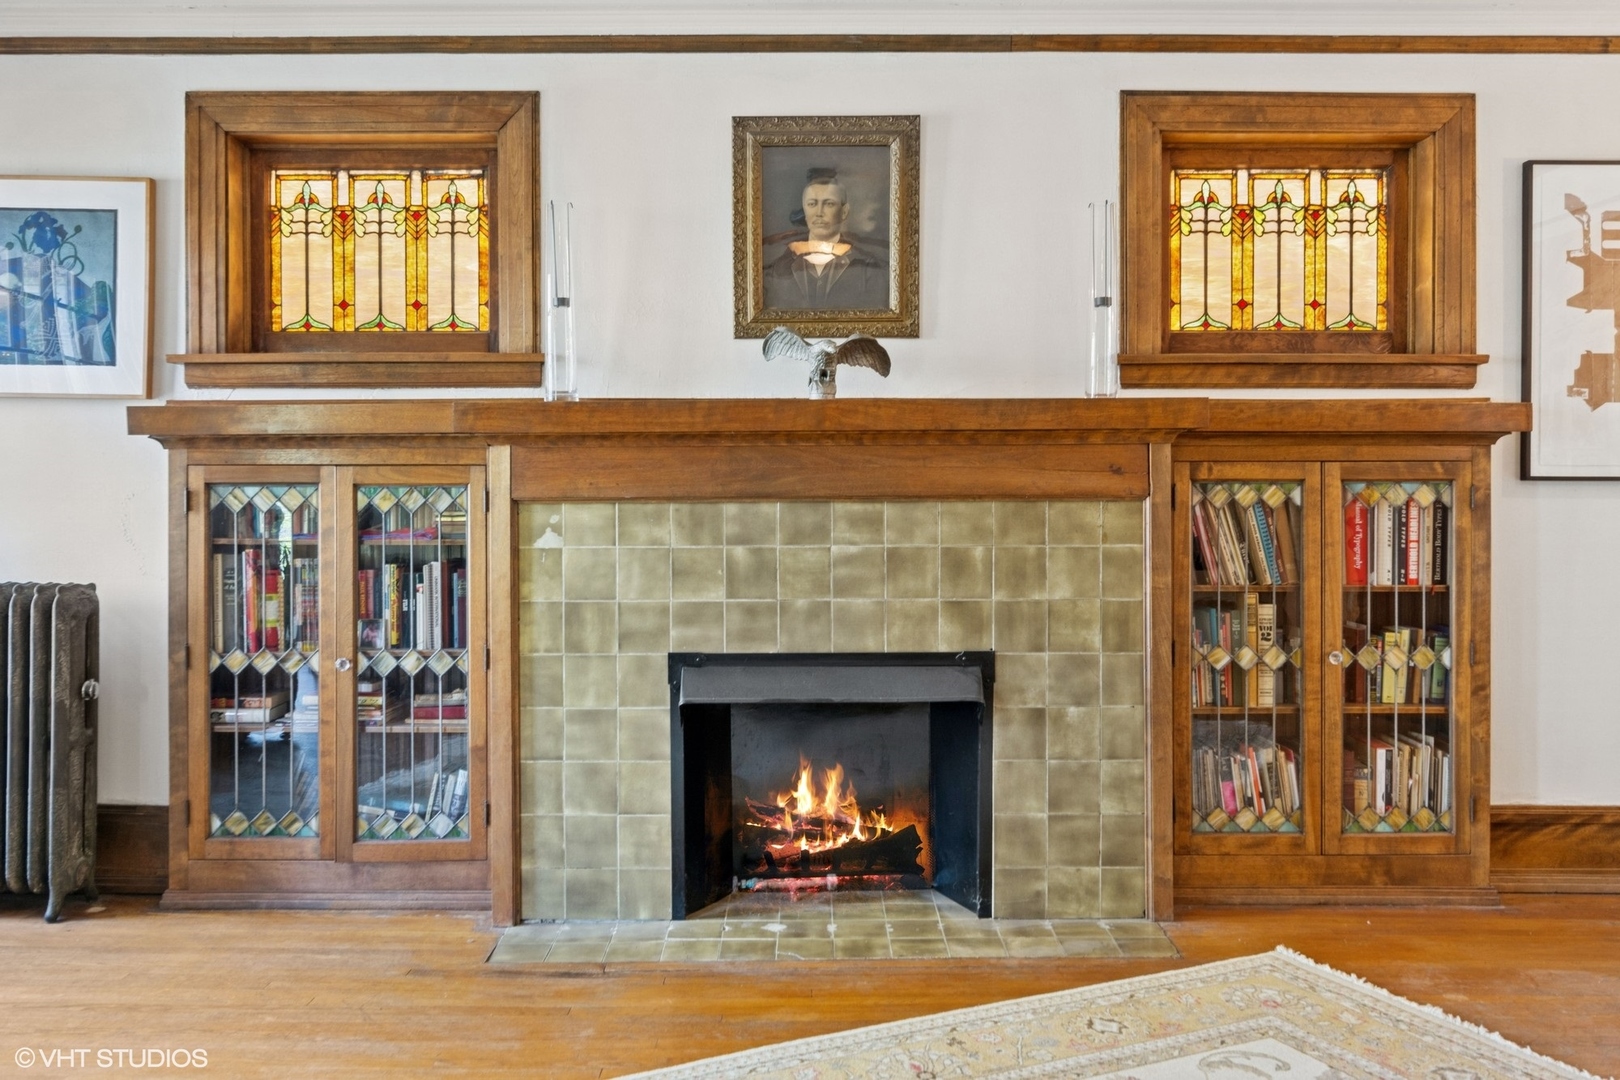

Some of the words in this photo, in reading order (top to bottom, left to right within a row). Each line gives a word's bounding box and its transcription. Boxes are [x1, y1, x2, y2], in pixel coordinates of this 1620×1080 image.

[1409, 501, 1419, 541] HEADLINES
[1434, 508, 1442, 527] TYPES
[1354, 532, 1363, 570] Typography
[1409, 542, 1419, 579] BERTHOLD
